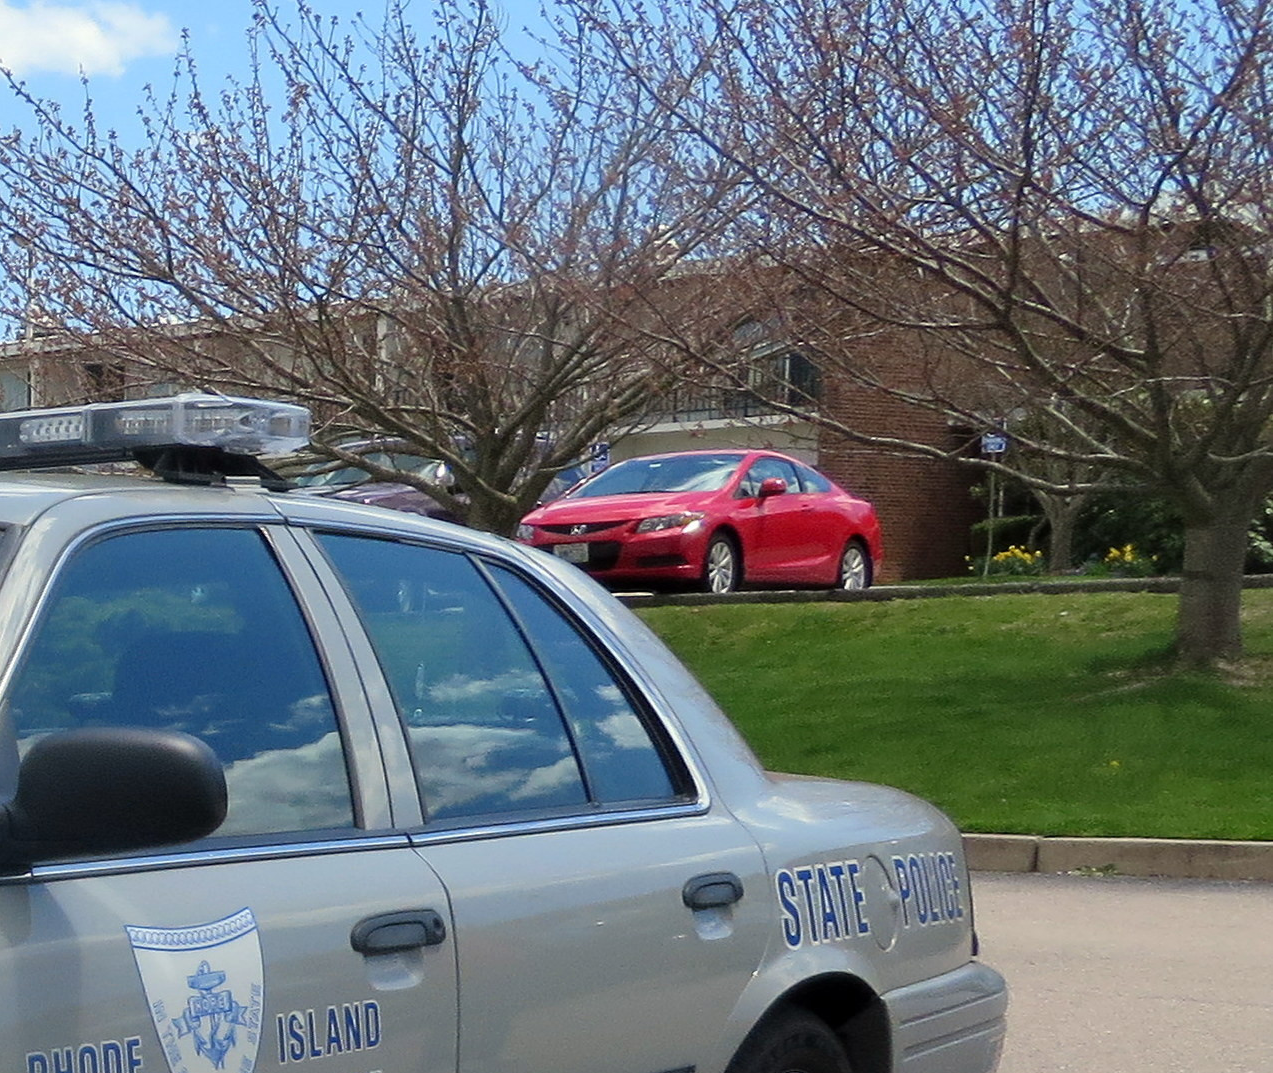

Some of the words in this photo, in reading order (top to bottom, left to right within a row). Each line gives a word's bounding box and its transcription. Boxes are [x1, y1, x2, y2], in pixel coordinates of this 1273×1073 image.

[775, 859, 871, 950] STATE
[891, 851, 963, 929] POLICE
[276, 1001, 382, 1064] ISLAND
